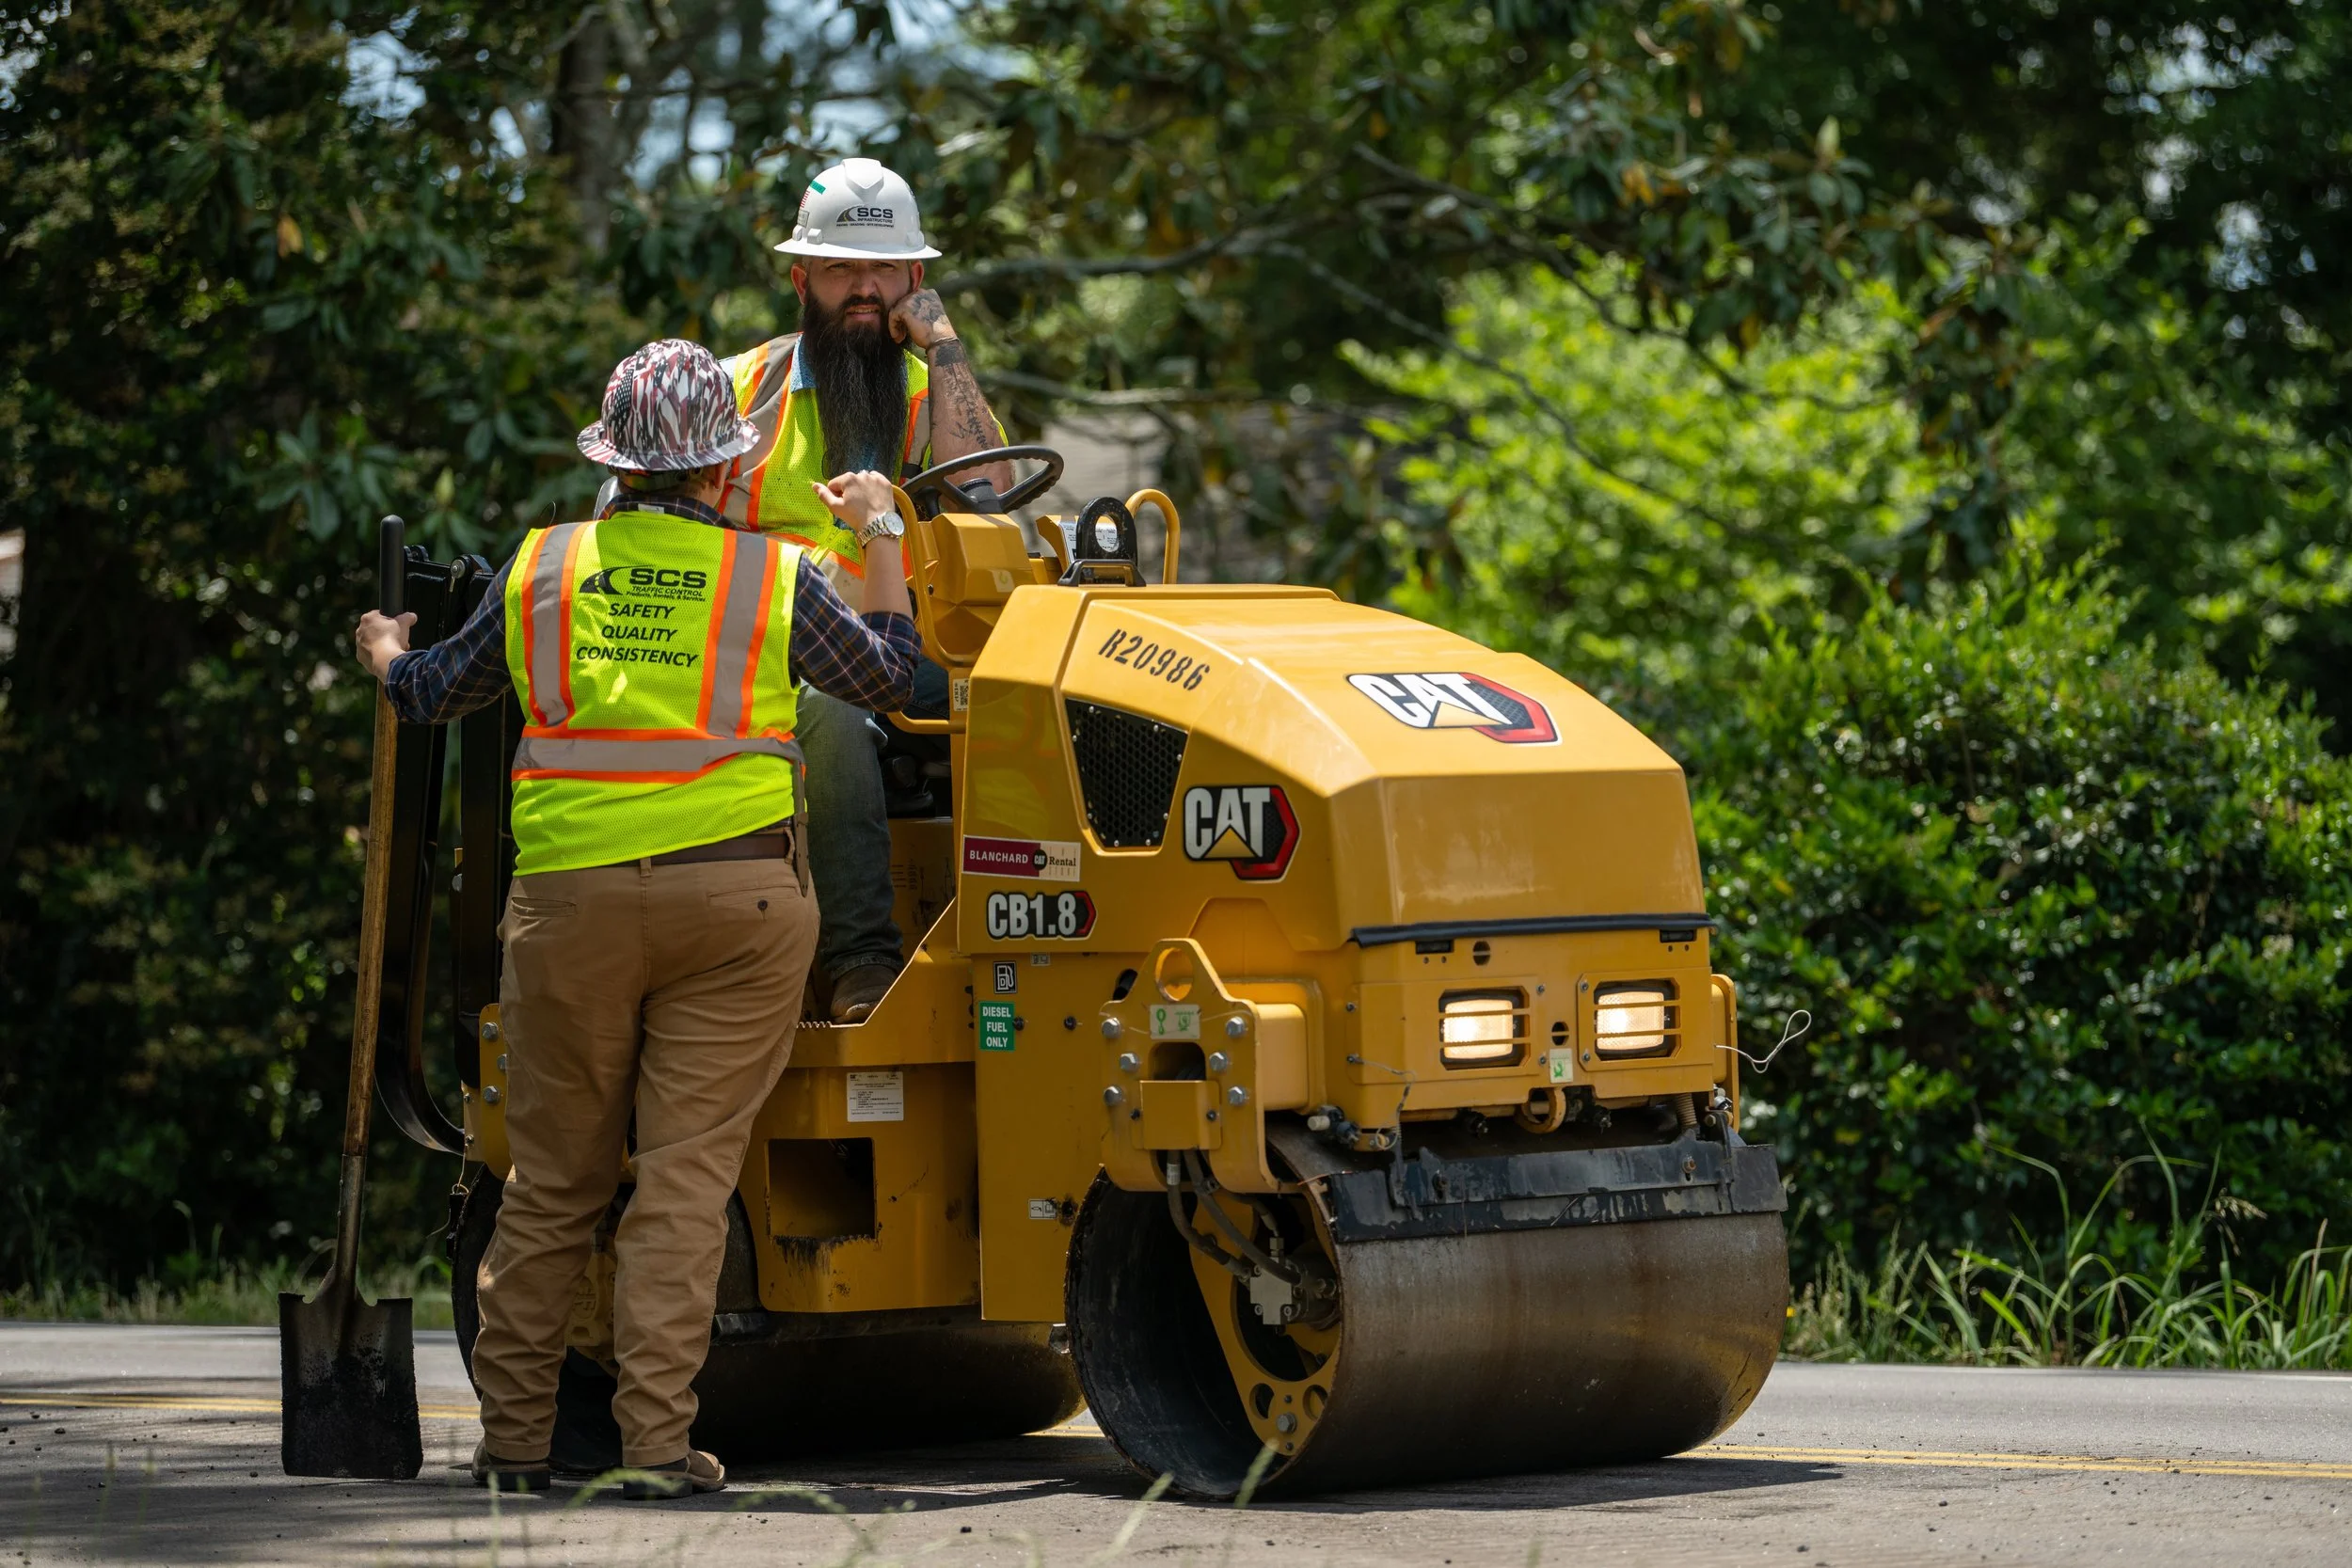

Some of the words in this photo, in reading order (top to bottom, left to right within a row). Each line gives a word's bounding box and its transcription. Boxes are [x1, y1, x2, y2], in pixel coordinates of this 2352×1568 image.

[857, 207, 894, 219] SCS
[628, 567, 707, 589] SCS
[632, 585, 664, 594] TRAFFIC
[664, 588, 704, 597] CONTROL
[608, 603, 676, 620] SAFETY
[601, 625, 678, 642] QUALITY
[576, 646, 700, 668] CONSISTENCY
[1098, 628, 1211, 691] R20986
[1347, 673, 1515, 729] CAT
[1184, 786, 1271, 860] CAT
[969, 849, 1029, 864] BLANCHARD
[1034, 854, 1046, 865] CAT
[1048, 856, 1077, 867] Rental
[988, 893, 1077, 938] CB1.8
[982, 1006, 1011, 1018] DIESEL
[986, 1022, 1009, 1033] FUEL
[986, 1036, 1009, 1048] ONLY
